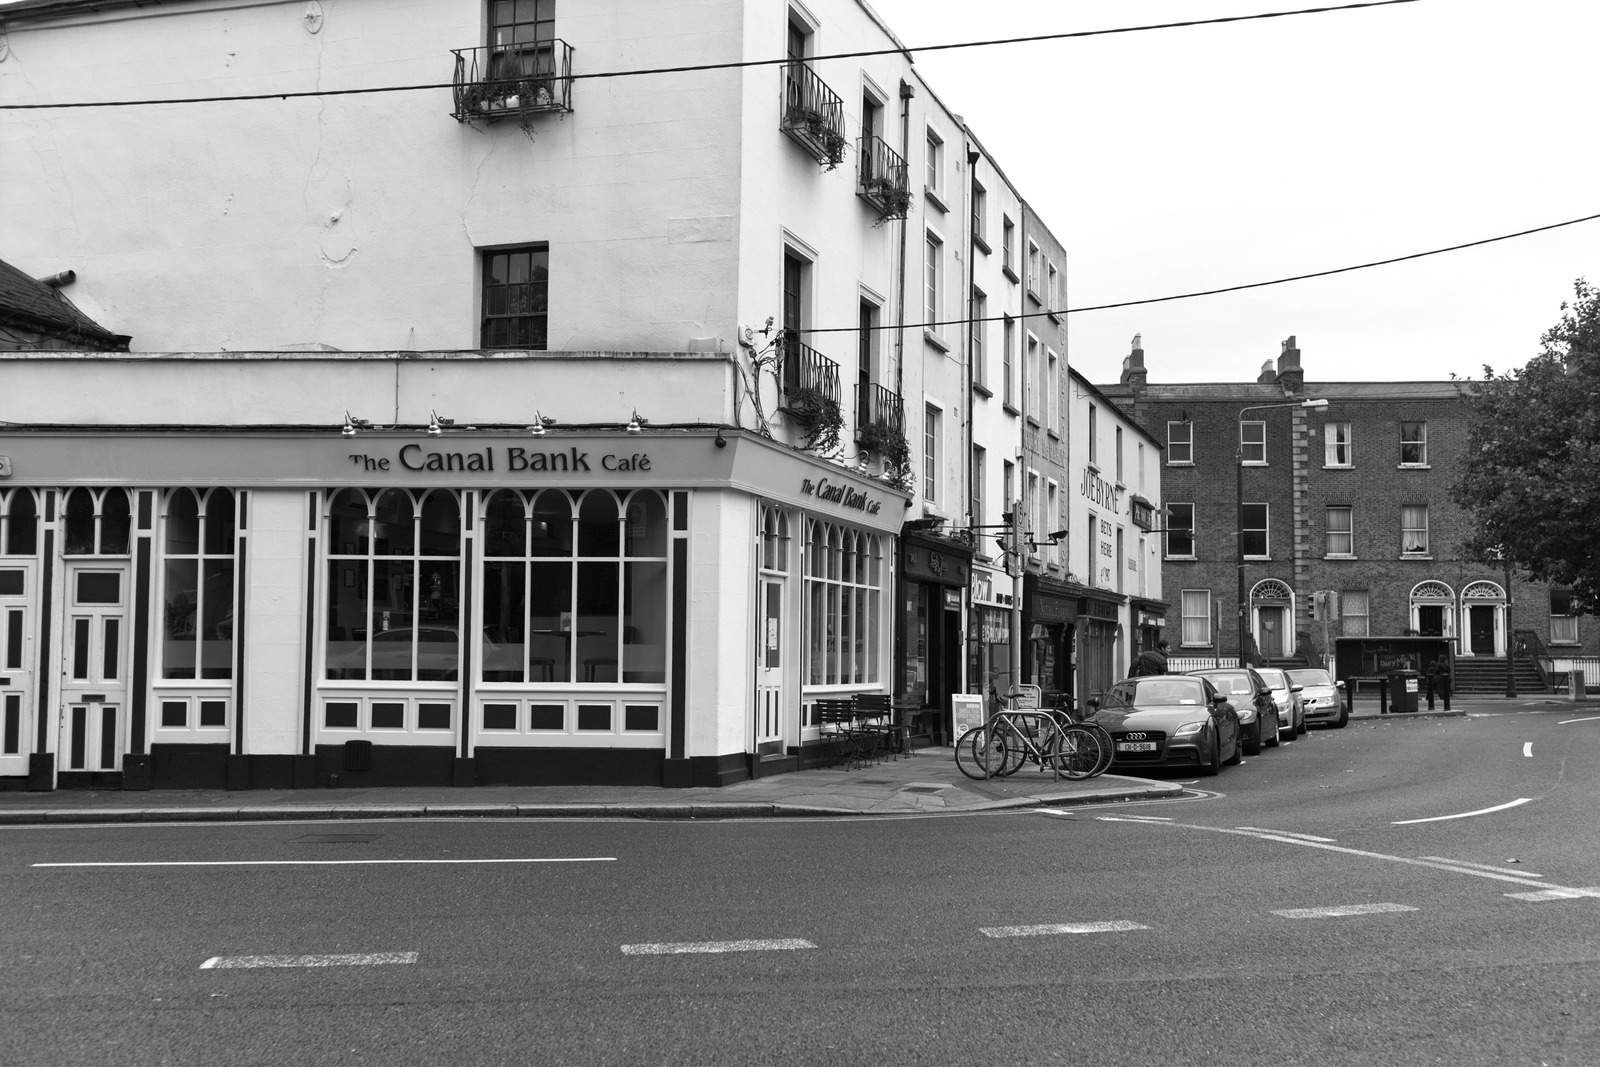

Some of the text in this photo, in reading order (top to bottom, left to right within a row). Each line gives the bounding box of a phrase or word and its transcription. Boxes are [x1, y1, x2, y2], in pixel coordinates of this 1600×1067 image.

[349, 444, 652, 472] The Canal Bank Café
[801, 477, 881, 515] The Canal Bank Café
[1081, 468, 1096, 502] JOE
[1096, 476, 1119, 515] BYRNE
[1100, 519, 1112, 537] BETS
[1100, 540, 1112, 559] HERE
